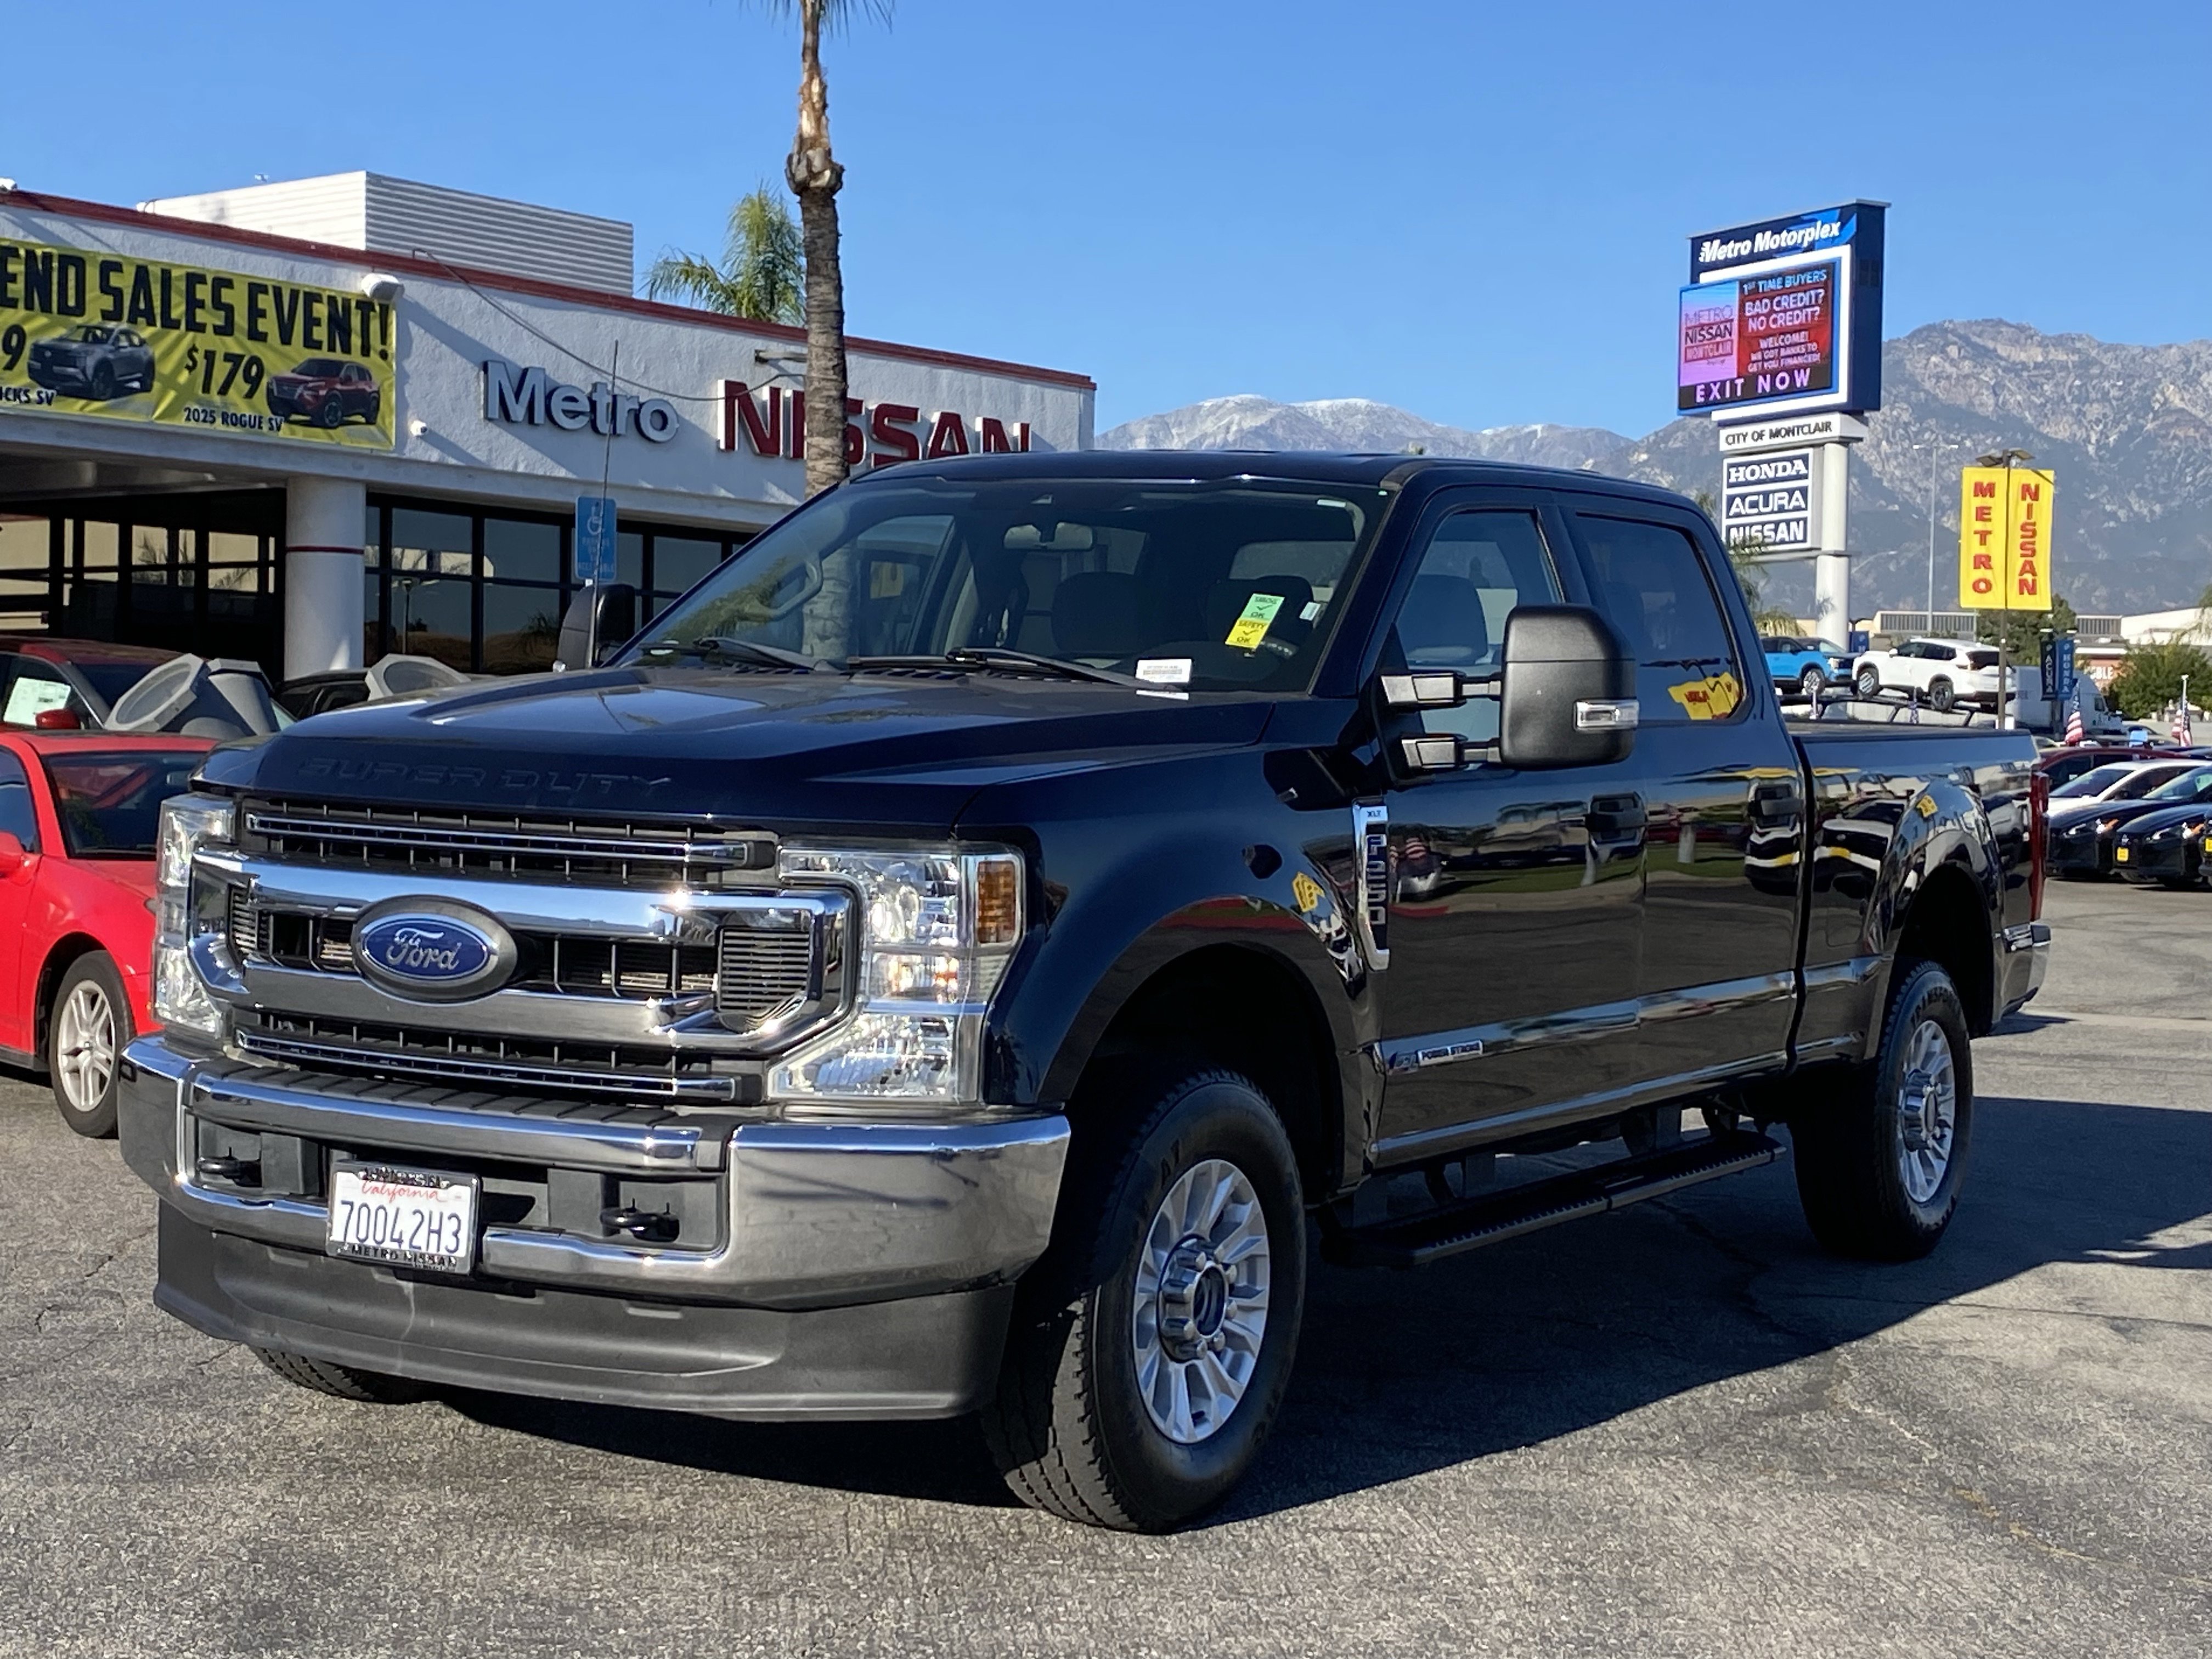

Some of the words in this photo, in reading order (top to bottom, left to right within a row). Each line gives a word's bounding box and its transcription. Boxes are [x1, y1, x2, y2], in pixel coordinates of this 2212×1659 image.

[1699, 239, 1752, 262] Metro
[1754, 221, 1841, 253] Motorplex
[1785, 269, 1827, 288] BUYERS
[99, 259, 235, 337] SALES
[247, 281, 390, 361] EVENT!
[1745, 296, 1769, 314] BAD
[1773, 289, 1825, 309] CREDIT?
[1684, 324, 1733, 345] NISSAN
[1748, 315, 1768, 332] NO
[1770, 307, 1821, 328] CREDIT?
[184, 343, 264, 399] $179
[1696, 378, 1745, 403] EXIT
[1757, 368, 1810, 394] NOW
[36, 390, 54, 405] SV
[484, 359, 679, 443] Metro
[184, 407, 216, 424] 2025
[221, 411, 263, 430] ROGUE
[268, 417, 284, 432] SV
[1725, 432, 1748, 445] CITY
[1751, 429, 1765, 442] OF
[1769, 421, 1832, 439] MONTCLAIR
[1729, 459, 1808, 483] HONDA
[1729, 490, 1806, 516] ACURA
[1972, 481, 1996, 594] METRO
[2018, 483, 2040, 595] NISSAN
[297, 758, 486, 787] SUPER
[500, 770, 672, 797] DUTY
[386, 927, 462, 970] Ford
[341, 1200, 462, 1254] 70042H3
